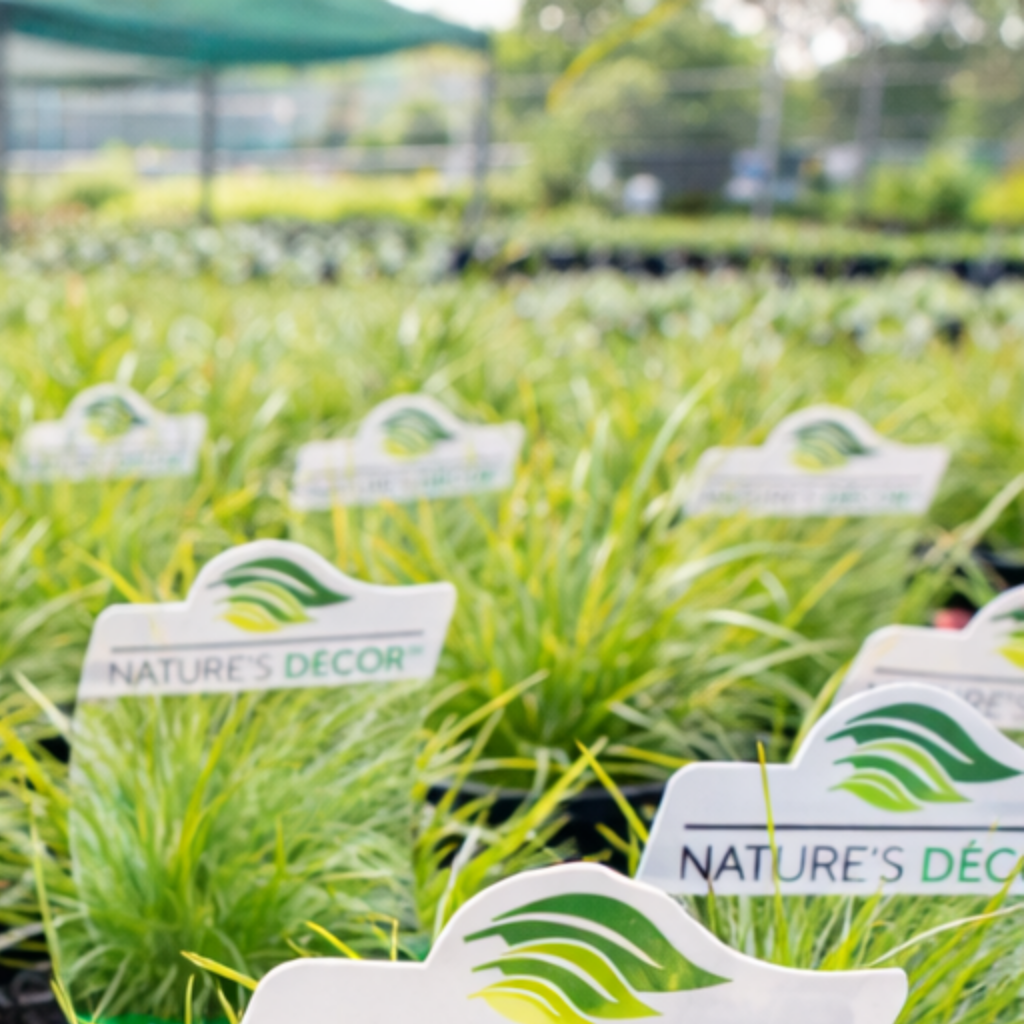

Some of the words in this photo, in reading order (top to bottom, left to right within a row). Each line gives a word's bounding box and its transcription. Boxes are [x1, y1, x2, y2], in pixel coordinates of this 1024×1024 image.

[108, 652, 273, 686] NATURE'S
[680, 844, 904, 883] NATURE'S
[922, 838, 1024, 883] DÉC
